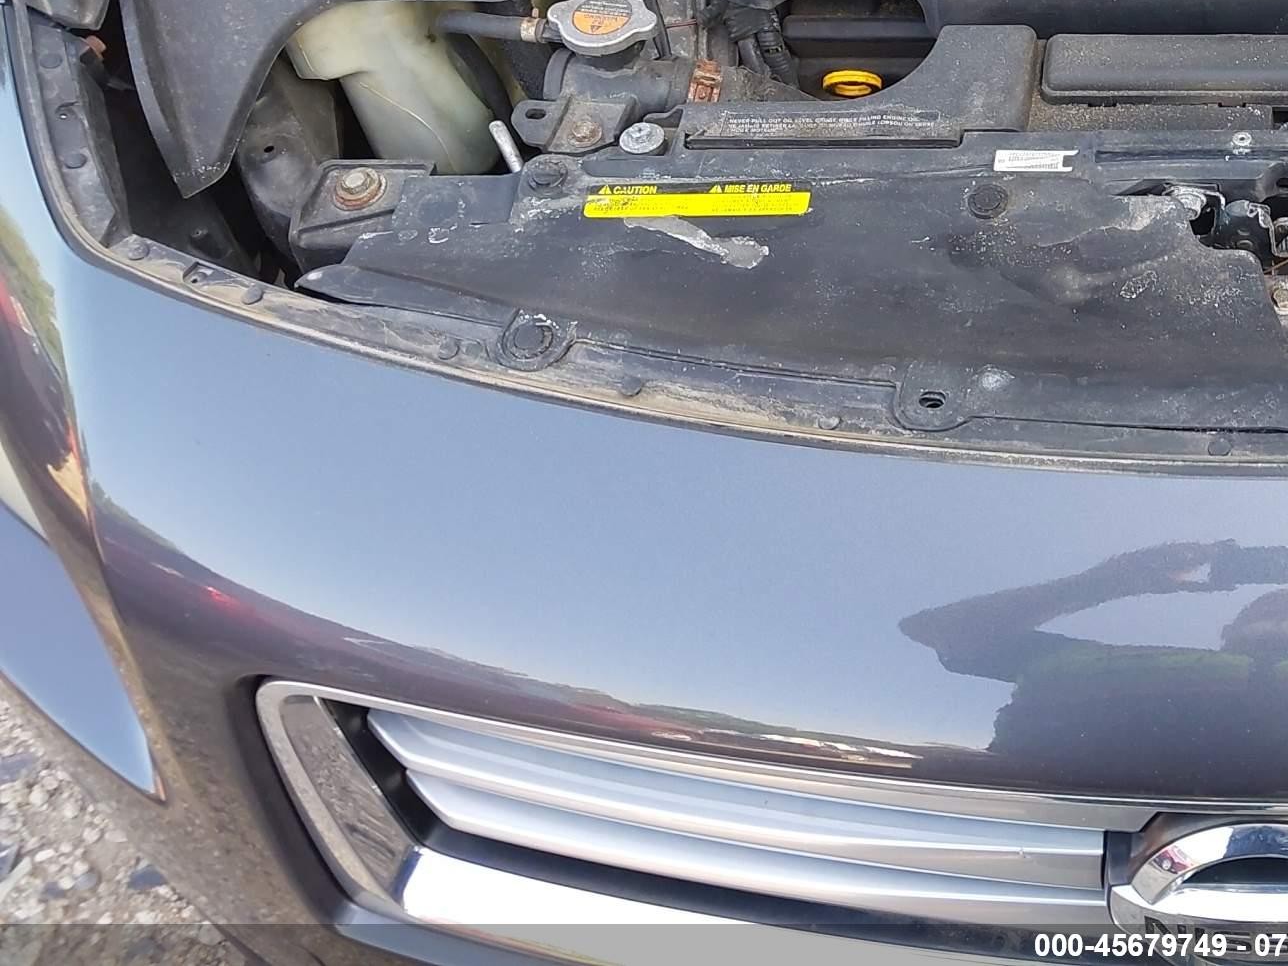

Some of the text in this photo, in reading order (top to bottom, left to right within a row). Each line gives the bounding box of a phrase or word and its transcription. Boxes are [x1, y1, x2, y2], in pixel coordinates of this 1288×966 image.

[612, 185, 658, 195] CAUTION
[724, 183, 792, 193] MISE EN GARDE
